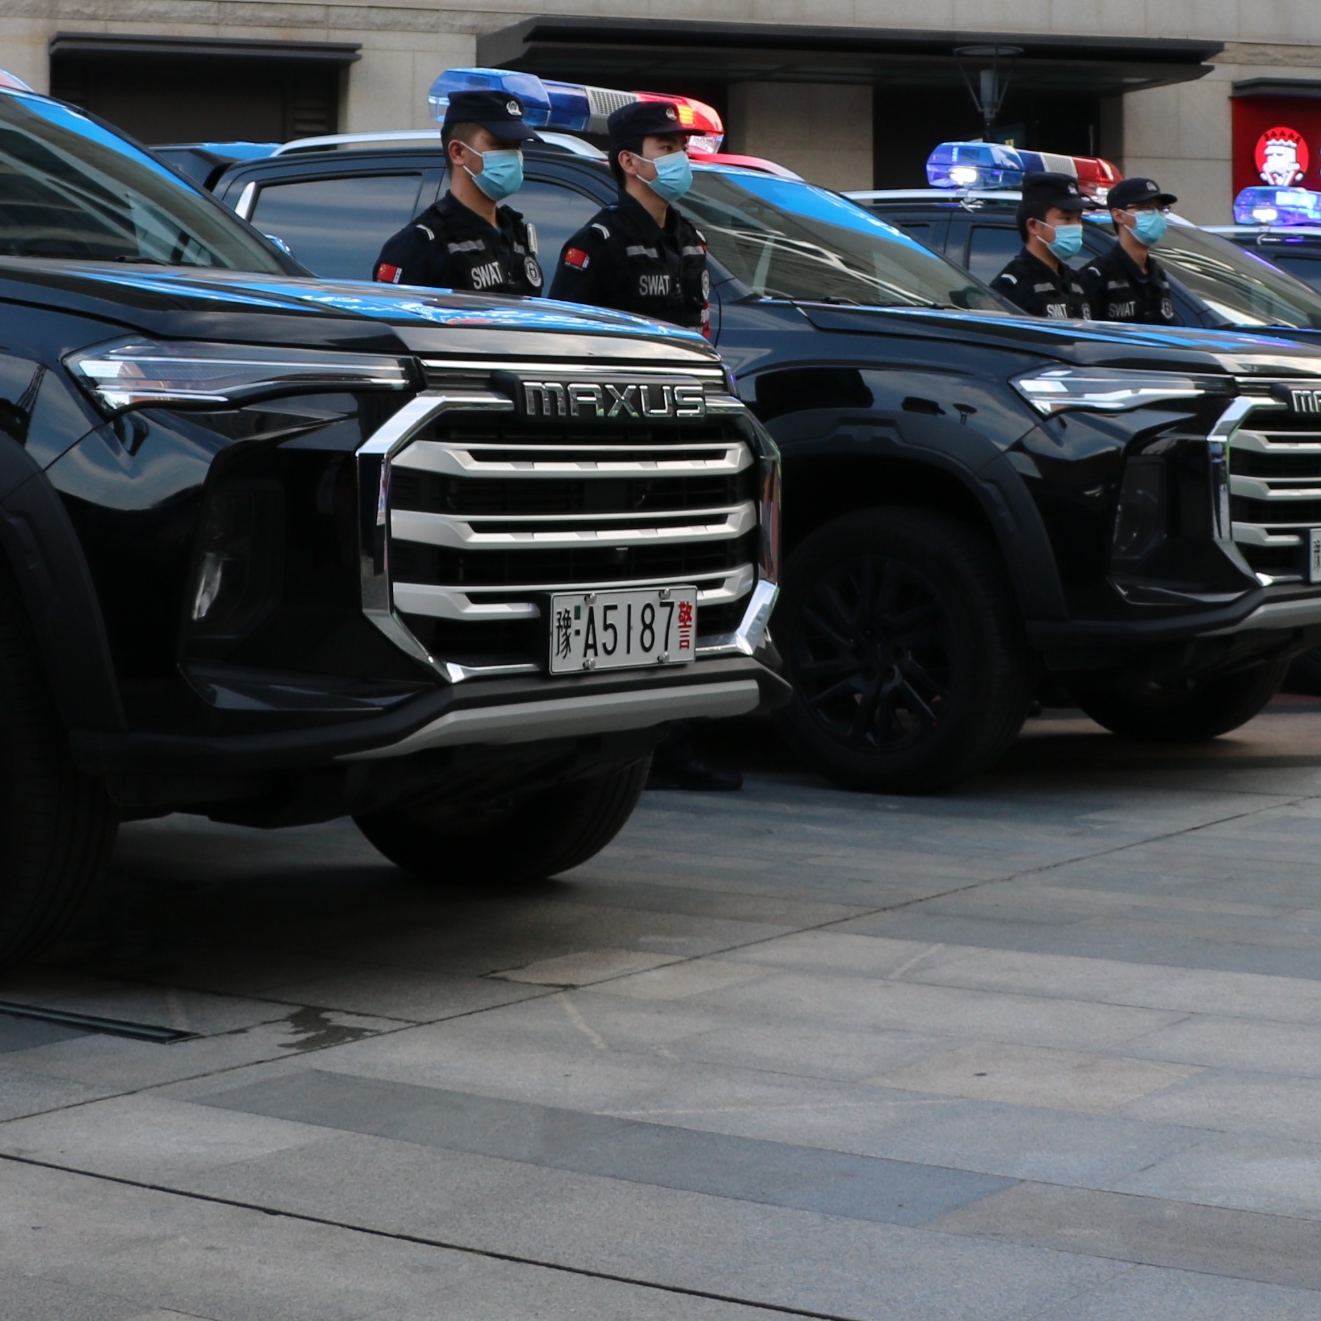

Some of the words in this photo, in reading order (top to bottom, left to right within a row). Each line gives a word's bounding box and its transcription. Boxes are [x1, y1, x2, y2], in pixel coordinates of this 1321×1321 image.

[470, 261, 503, 291] SWAT
[639, 274, 671, 296] SWAT
[1046, 303, 1068, 319] SWAT
[1108, 300, 1136, 319] SWAT
[522, 380, 707, 418] MAXUS
